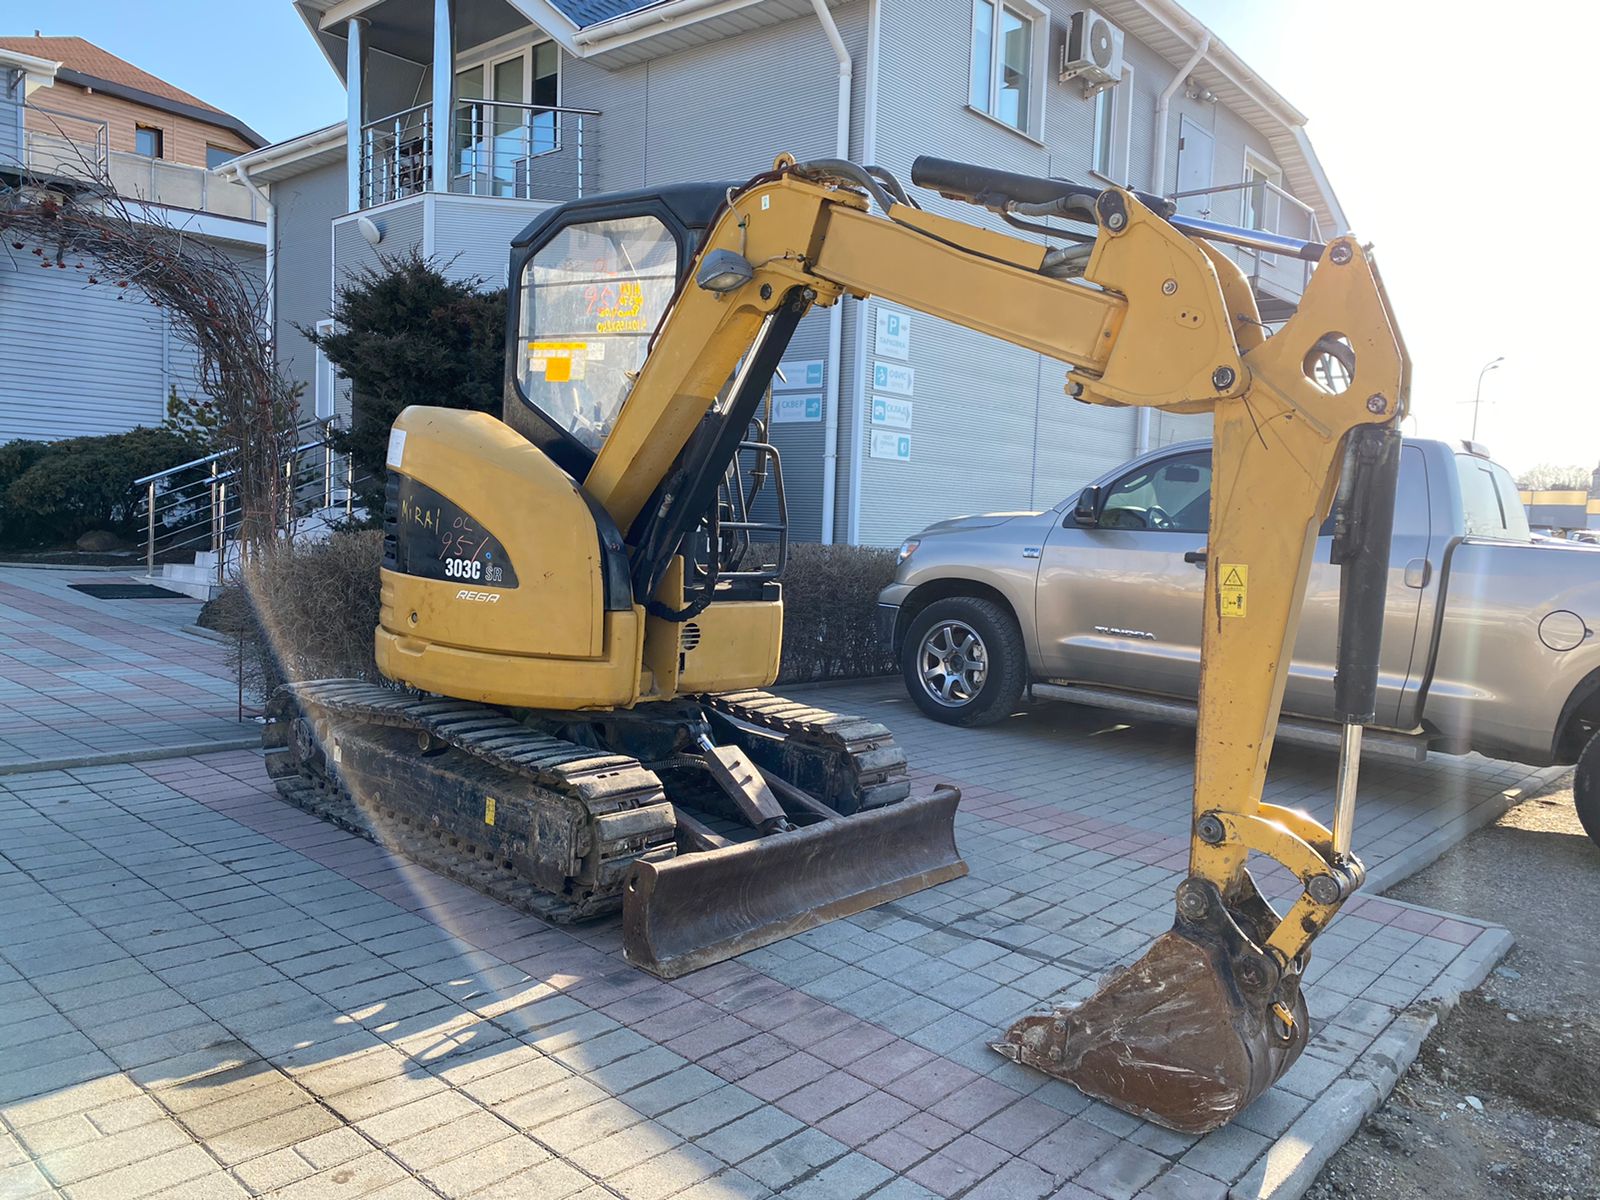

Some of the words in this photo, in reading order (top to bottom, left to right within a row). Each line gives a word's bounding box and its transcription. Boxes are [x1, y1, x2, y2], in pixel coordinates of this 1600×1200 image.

[782, 400, 804, 408] СКВЕР
[445, 557, 481, 580] 303C
[485, 565, 502, 581] SR
[456, 590, 501, 603] REGA
